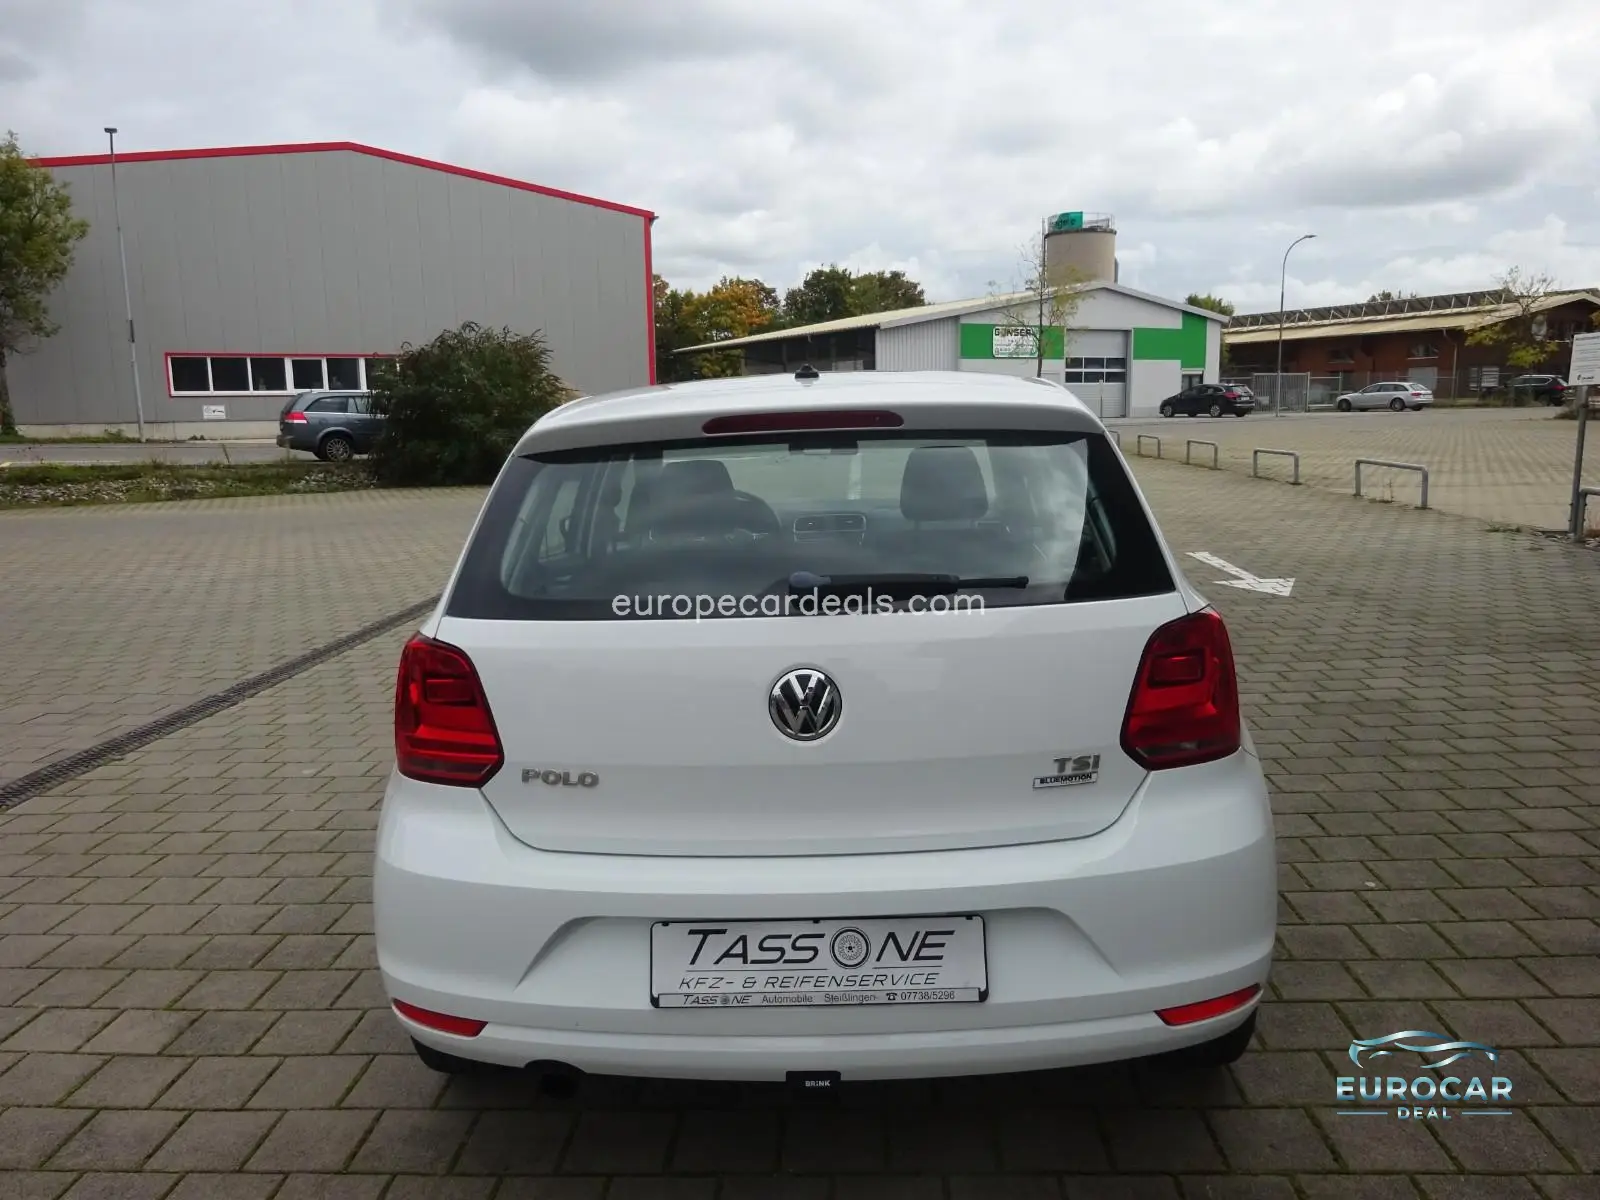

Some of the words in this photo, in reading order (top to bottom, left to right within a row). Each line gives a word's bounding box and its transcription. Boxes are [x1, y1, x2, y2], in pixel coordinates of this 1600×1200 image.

[1053, 754, 1100, 773] TSI
[521, 768, 599, 787] POLO
[1039, 772, 1092, 784] BLUEMOTION
[763, 973, 940, 988] REIFENSERVICE
[762, 994, 813, 1003] Automobile
